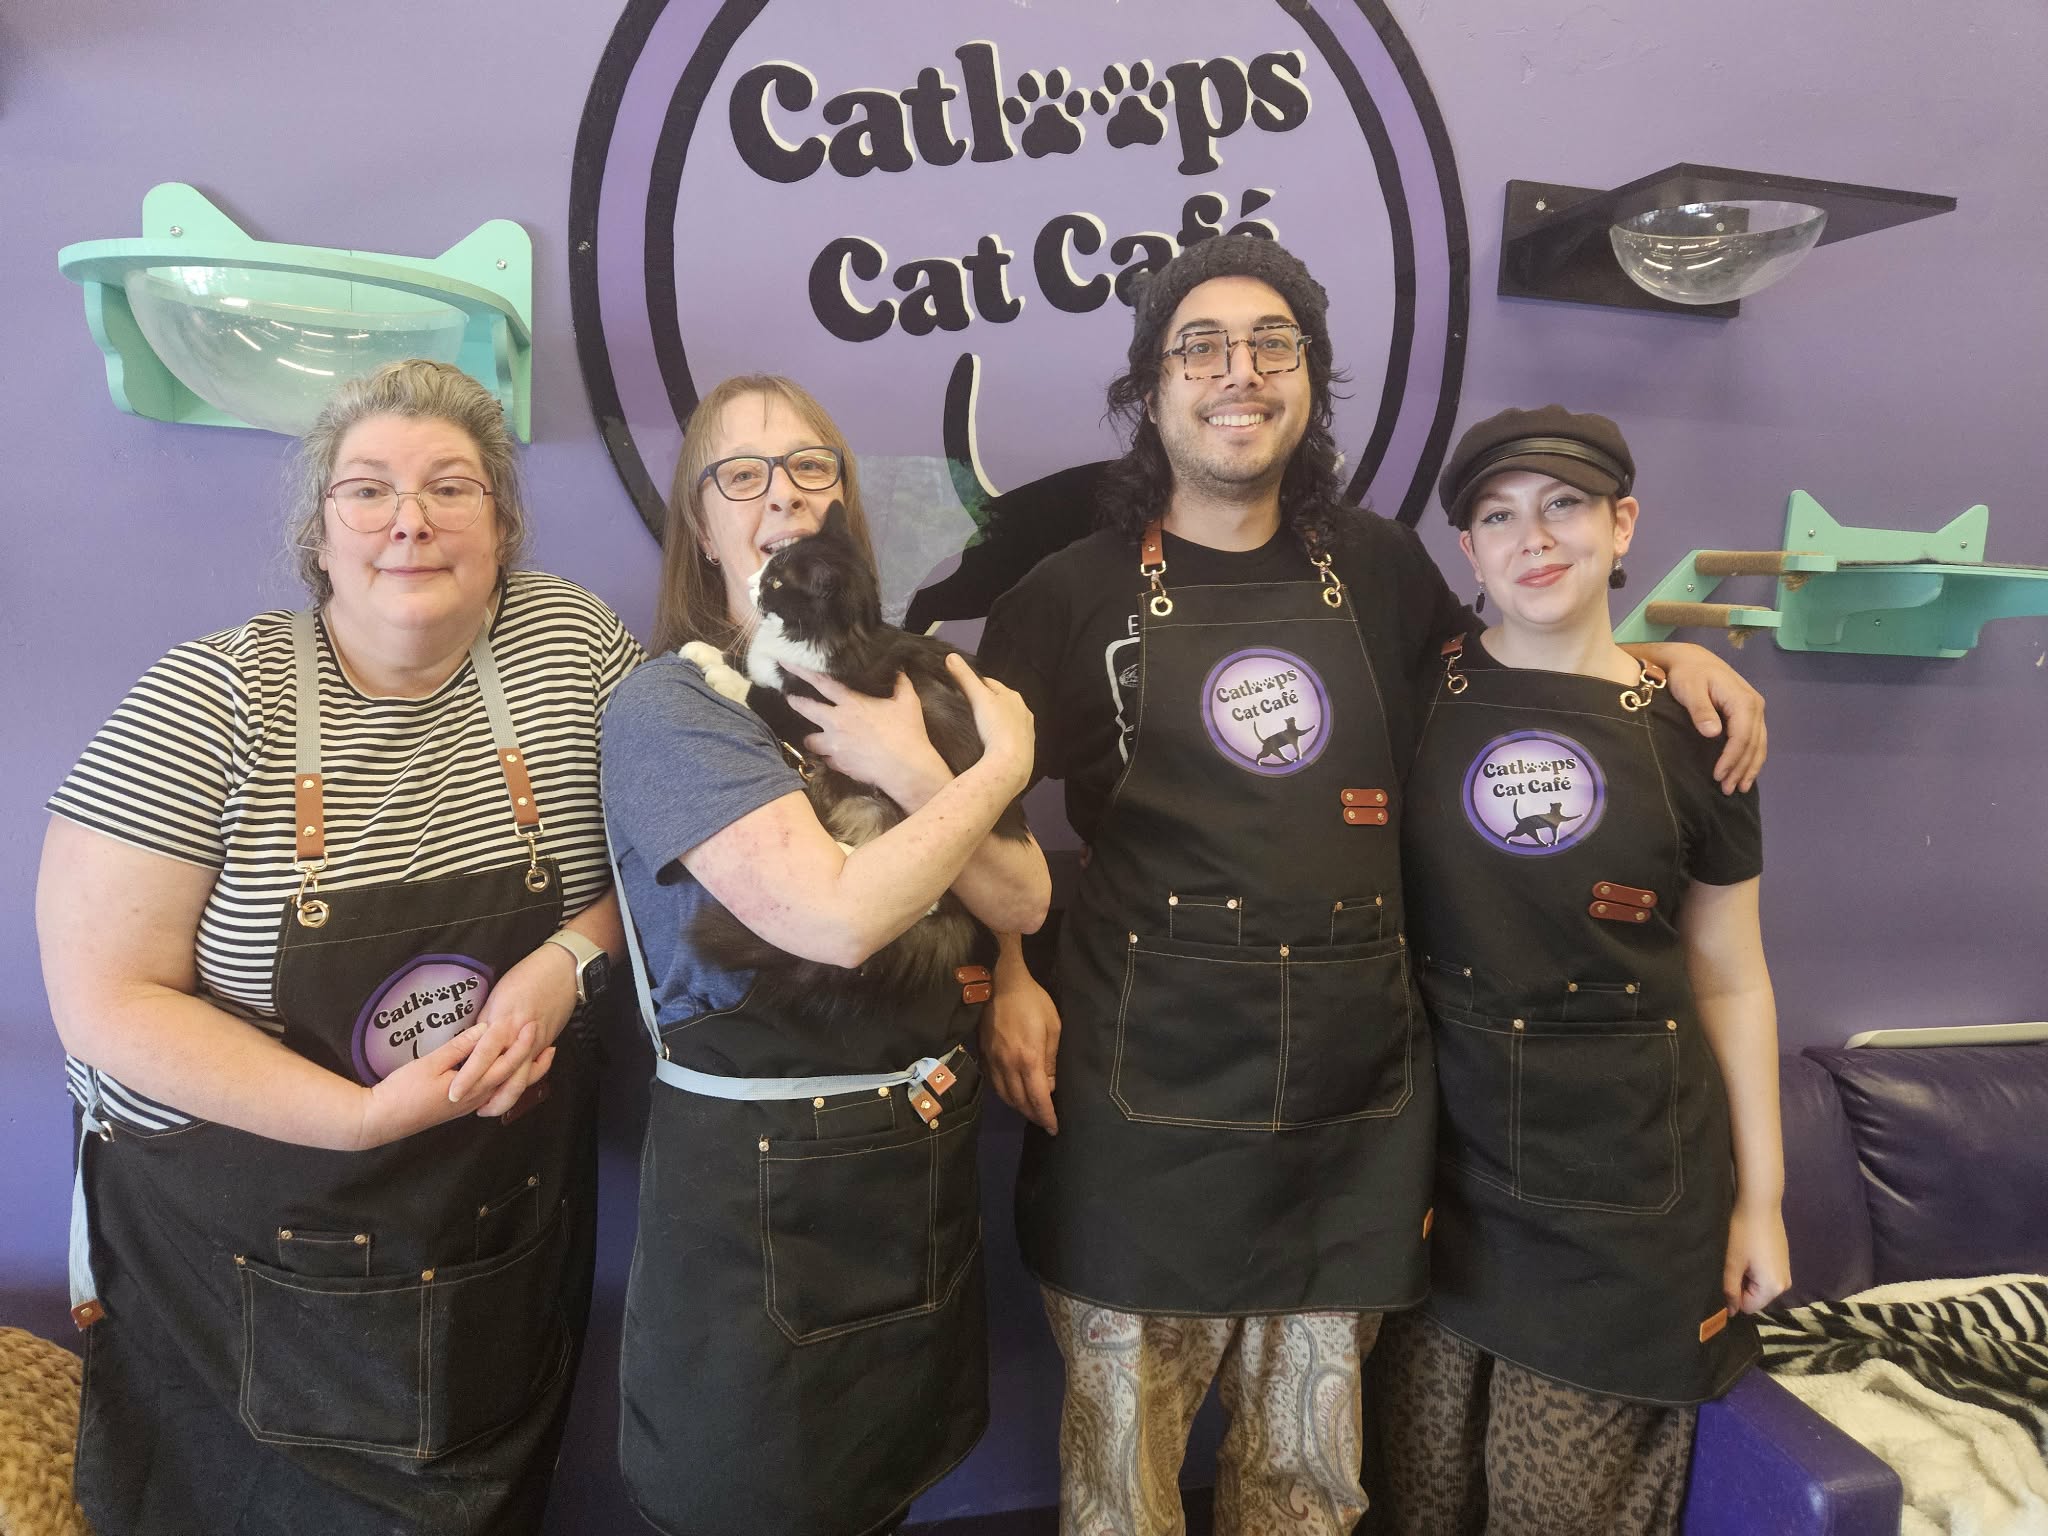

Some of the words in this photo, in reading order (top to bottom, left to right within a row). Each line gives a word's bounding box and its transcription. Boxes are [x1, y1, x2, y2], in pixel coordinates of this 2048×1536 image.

[809, 234, 1025, 343] Cat
[1232, 706, 1260, 722] Cat
[1260, 690, 1299, 714] Café
[1493, 782, 1526, 798] Cat
[1528, 776, 1572, 794] Café
[389, 1020, 424, 1047] Cat
[425, 999, 475, 1029] Café
